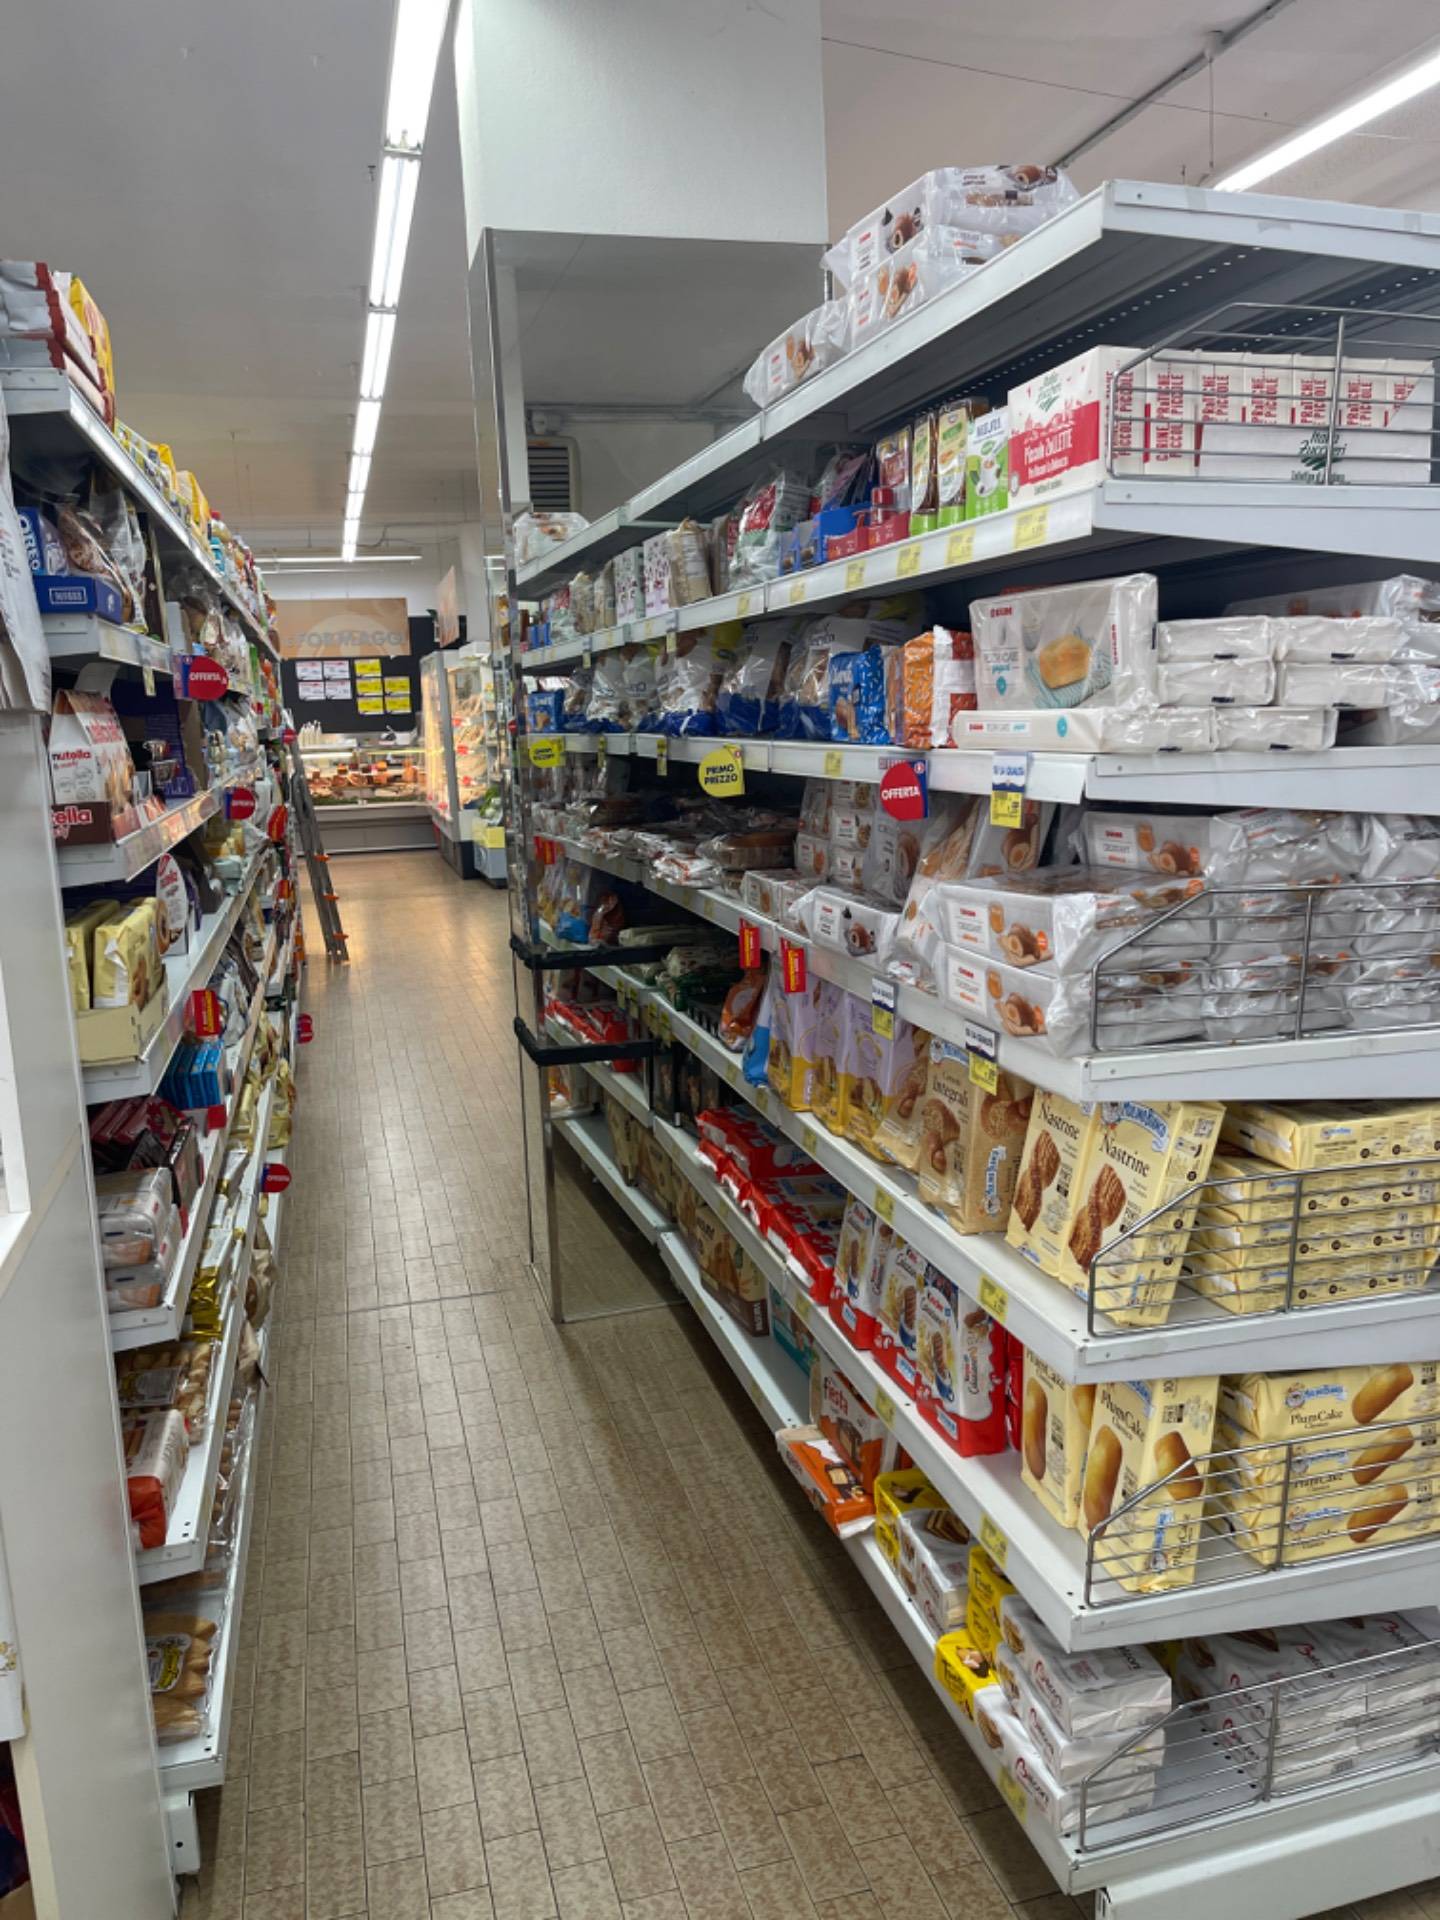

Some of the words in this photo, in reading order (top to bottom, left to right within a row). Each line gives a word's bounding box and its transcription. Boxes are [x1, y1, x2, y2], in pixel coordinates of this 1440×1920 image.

[706, 763, 735, 775] PRIMO
[704, 774, 738, 785] PREZZO
[881, 786, 920, 800] OFFERTA
[1099, 1134, 1151, 1177] Nastrine
[1100, 1390, 1145, 1442] PlumCake
[1290, 1409, 1344, 1426] PlumCake
